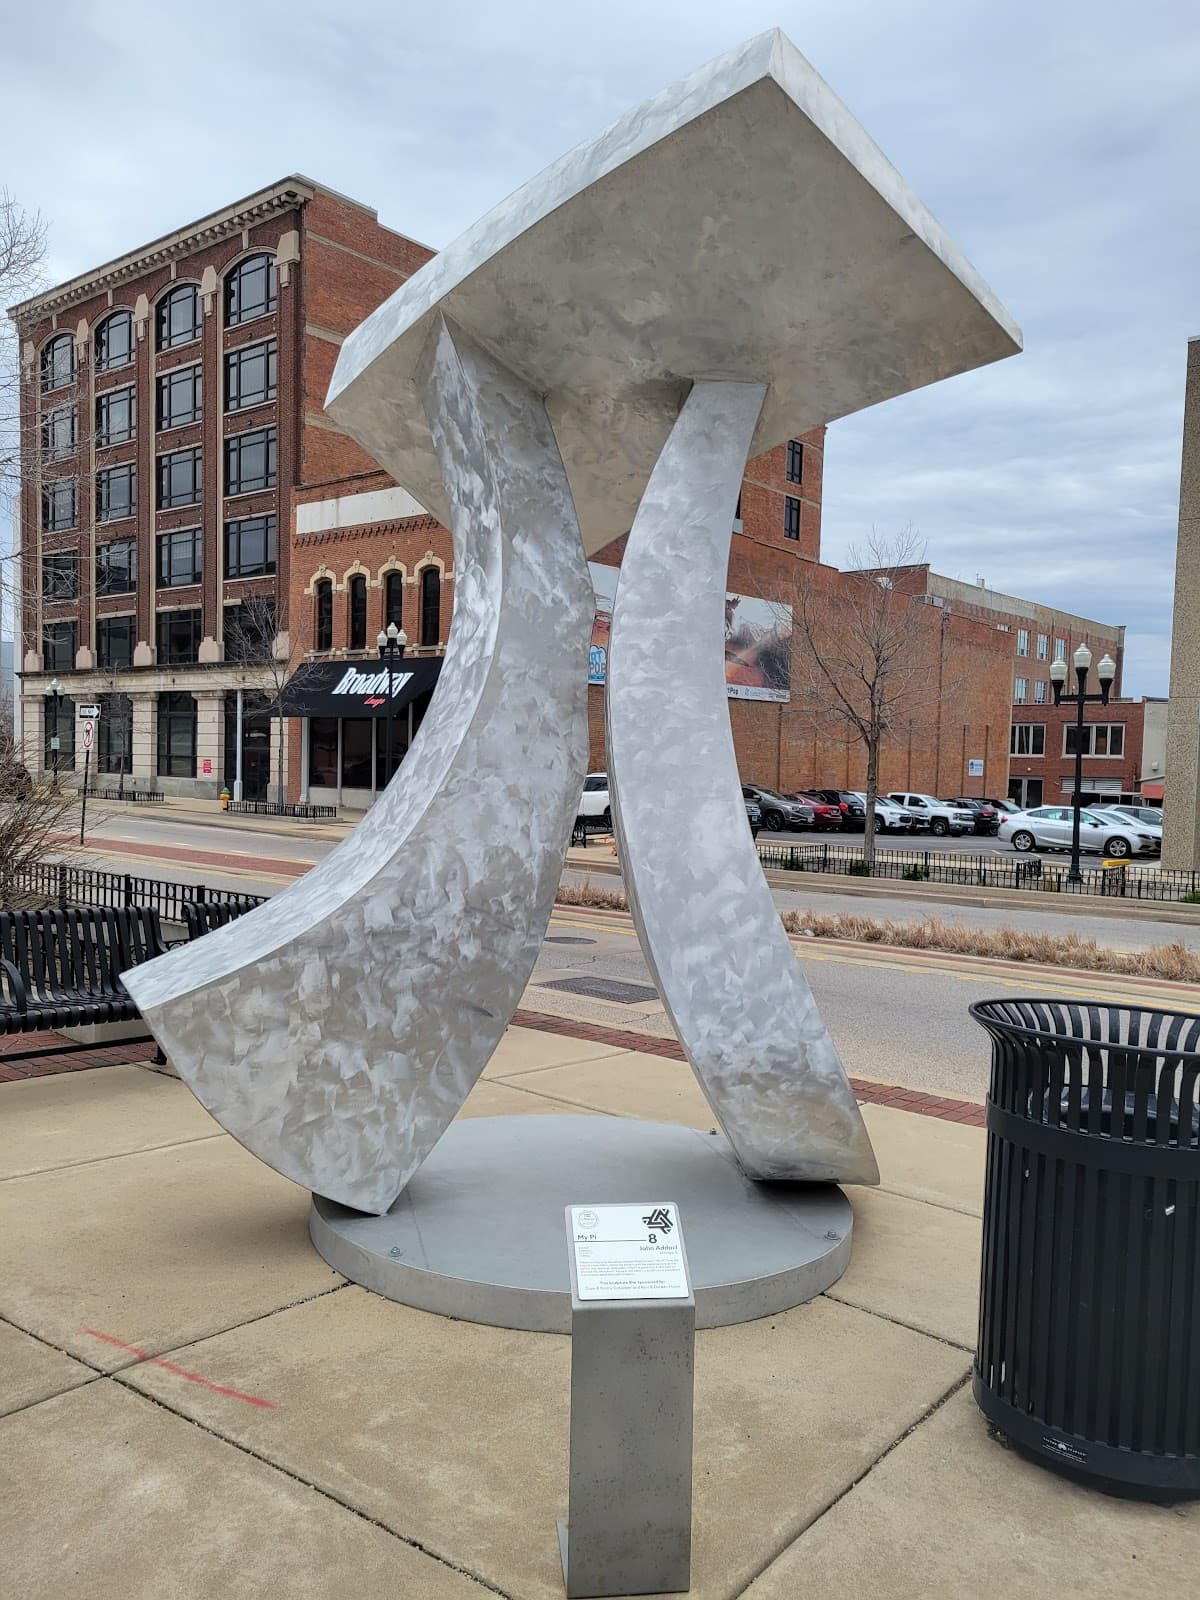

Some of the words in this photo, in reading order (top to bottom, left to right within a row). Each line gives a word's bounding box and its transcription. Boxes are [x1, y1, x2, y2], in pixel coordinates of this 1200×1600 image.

[591, 651, 603, 664] RT
[331, 667, 414, 698] Broadway
[648, 1233, 657, 1243] 8
